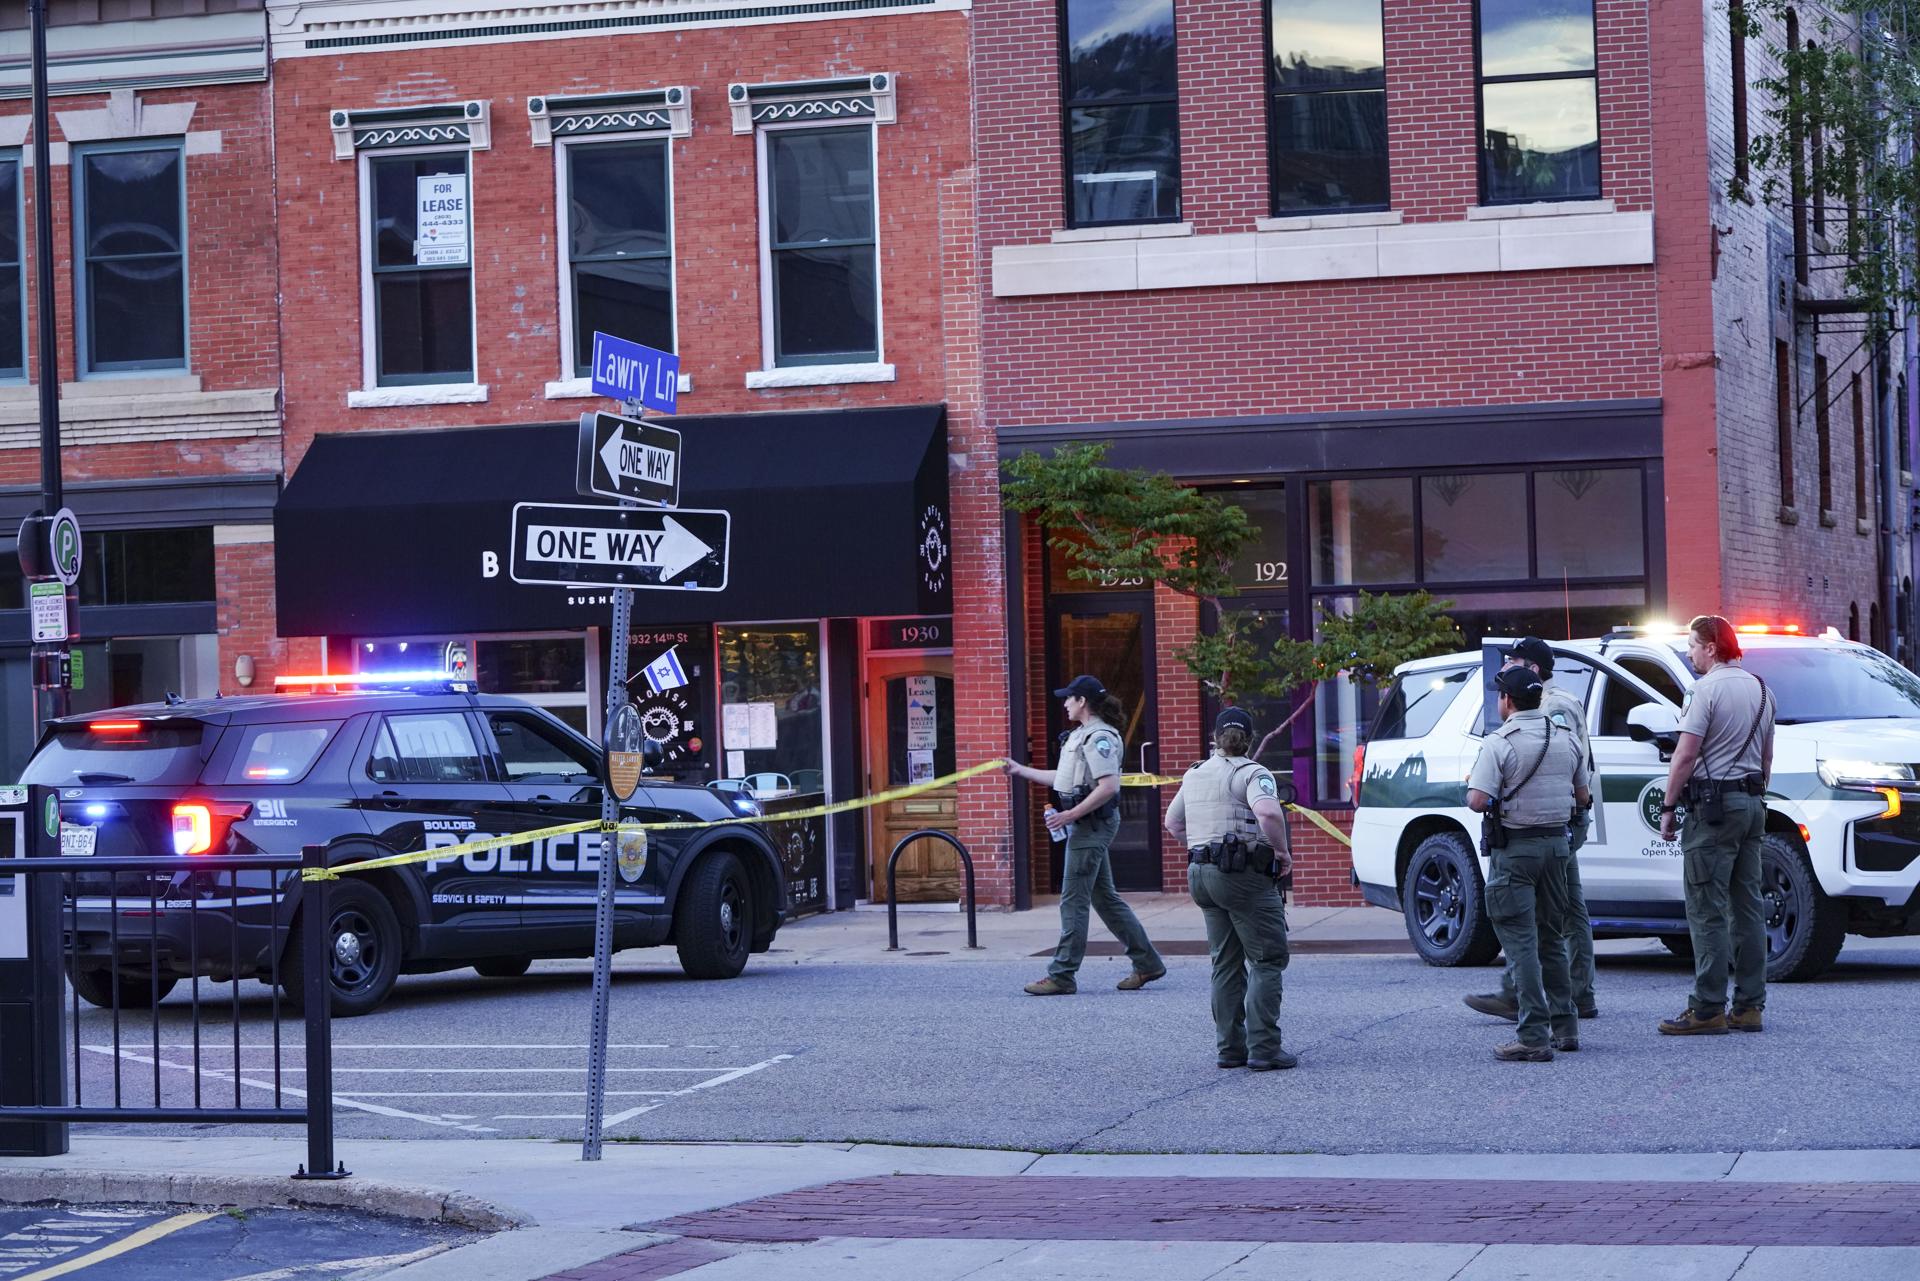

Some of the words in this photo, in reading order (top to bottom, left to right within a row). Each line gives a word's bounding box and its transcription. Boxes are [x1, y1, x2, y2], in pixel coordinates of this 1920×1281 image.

[434, 184, 452, 194] FOR
[422, 199, 463, 212] LEASE
[422, 219, 464, 227] 444-4333
[596, 340, 649, 401] Lawry
[655, 357, 676, 402] Ln
[619, 443, 643, 475] ONE
[647, 450, 671, 481] WAY
[537, 529, 597, 559] ONE
[607, 532, 664, 562] WAY
[1255, 562, 1288, 582] 192
[628, 634, 651, 645] 1932
[653, 633, 675, 644] 14th
[677, 632, 689, 643] St
[901, 626, 940, 642] 1930
[908, 687, 935, 697] Lease
[256, 799, 288, 818] 911
[1649, 804, 1685, 813] Boer
[1651, 813, 1686, 824] Coty
[424, 821, 477, 831] BOULDER
[1651, 840, 1675, 848] Parks
[425, 833, 600, 873] POLICE
[1641, 848, 1667, 858] Open
[1668, 848, 1685, 858] Spa
[432, 894, 465, 904] SERVICE
